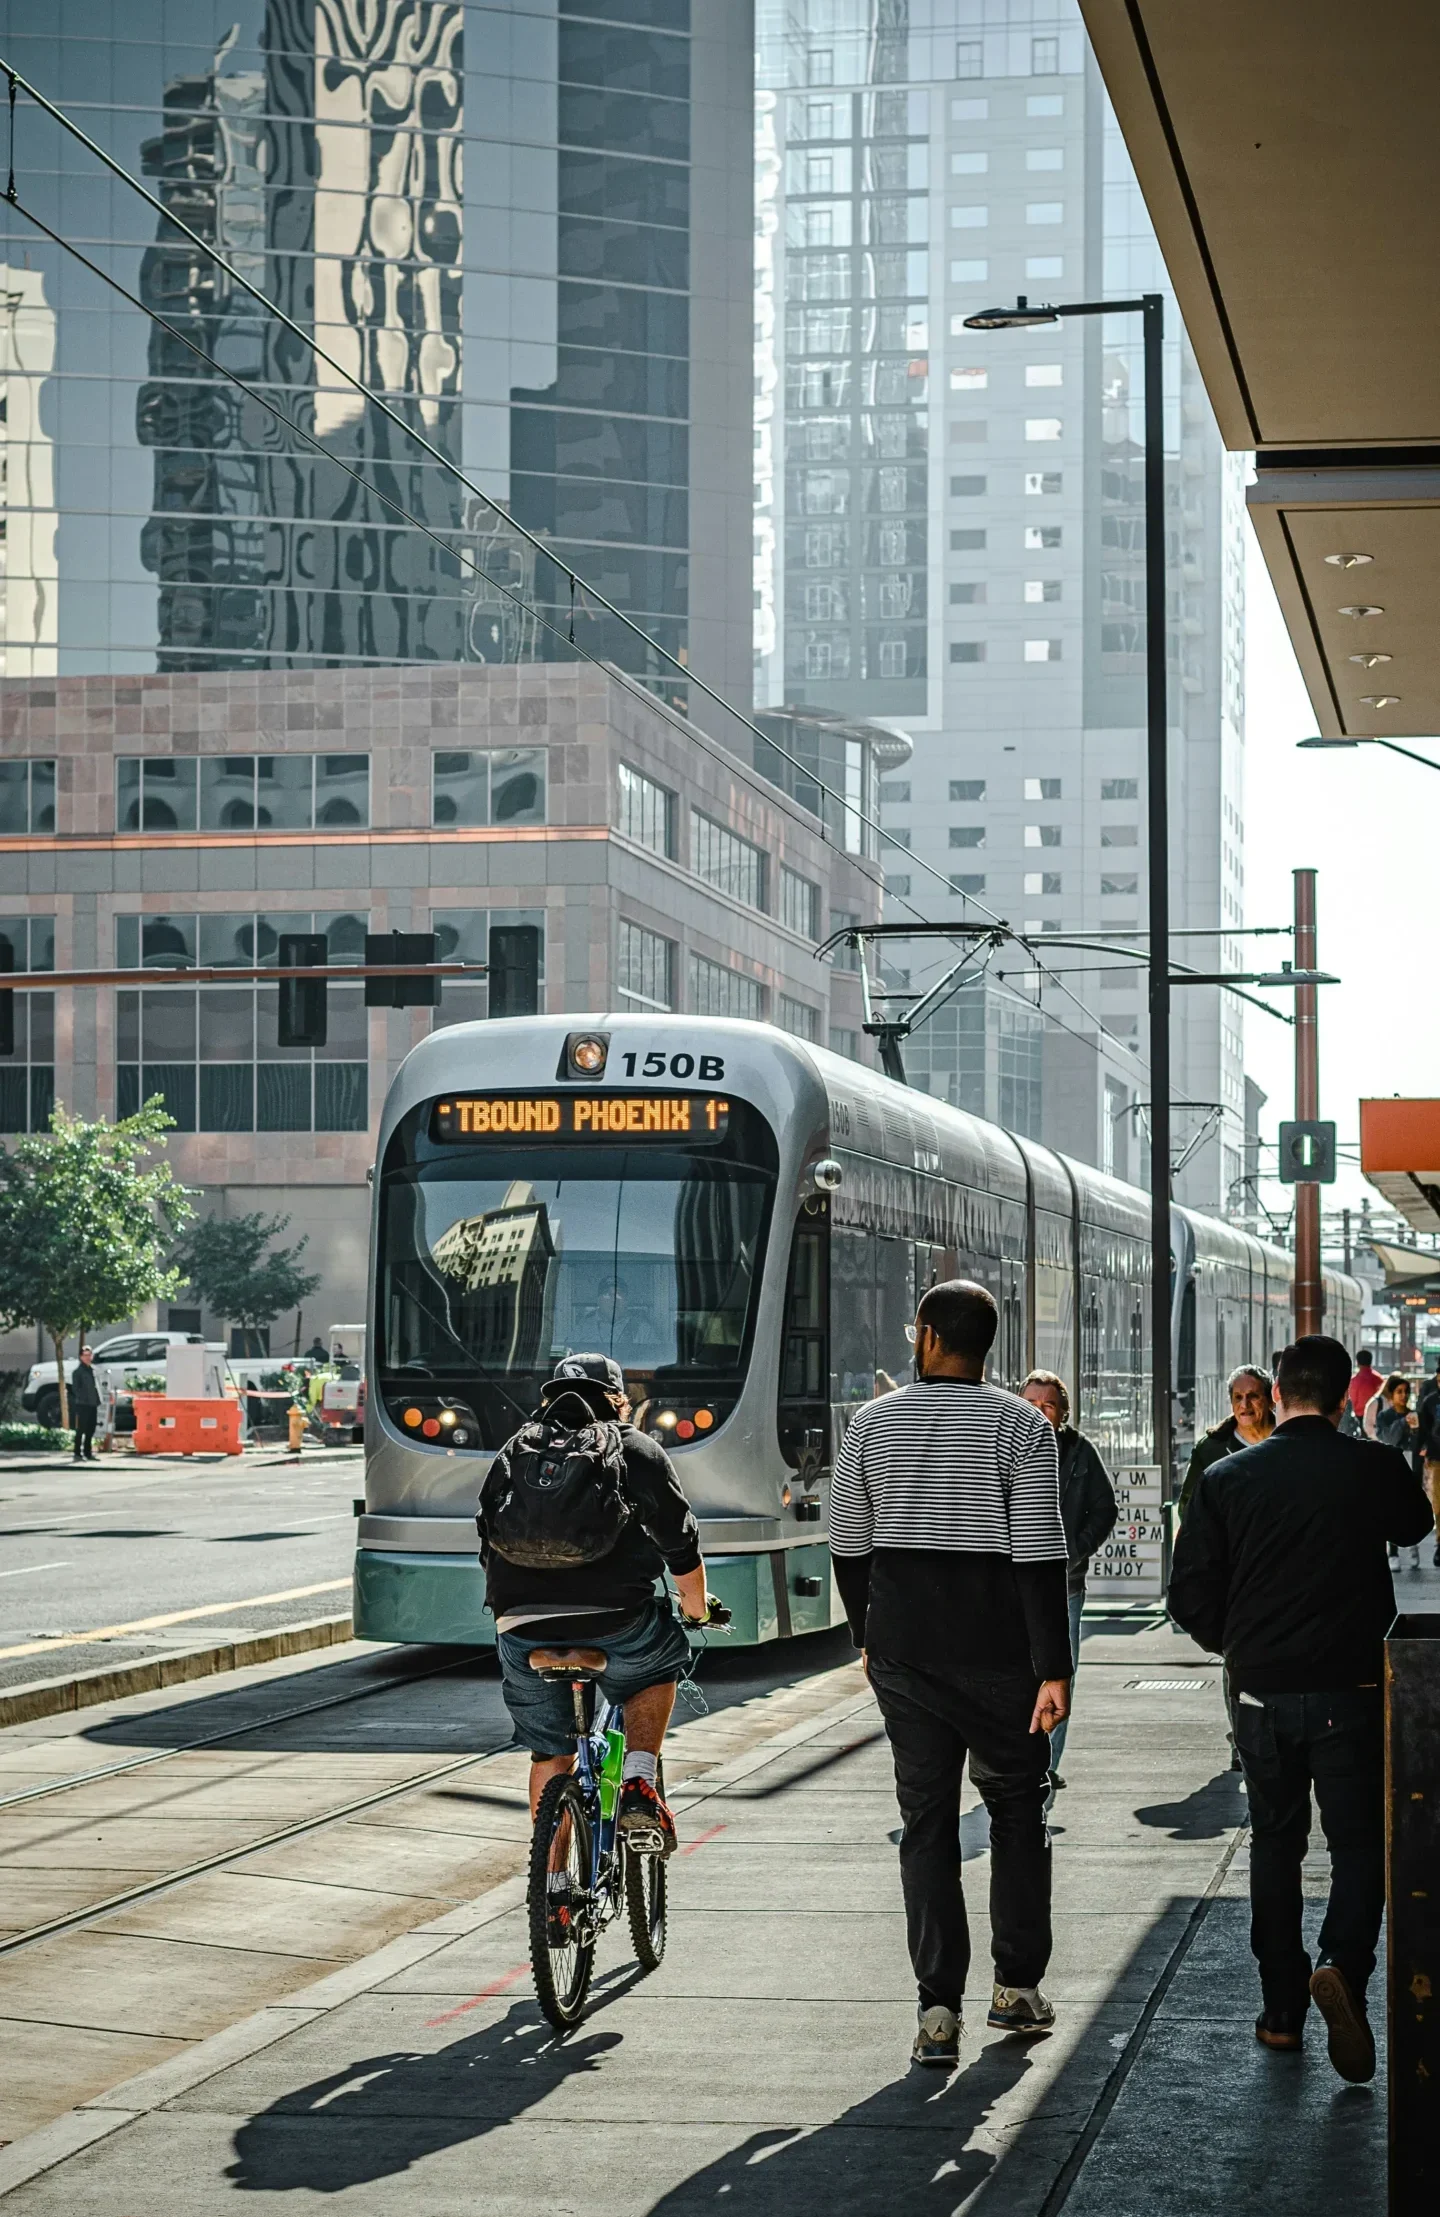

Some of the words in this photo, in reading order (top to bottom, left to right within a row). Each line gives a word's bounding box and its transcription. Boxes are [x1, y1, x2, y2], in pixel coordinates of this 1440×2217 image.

[621, 1052, 725, 1082] 150B
[456, 1101, 560, 1132] TBOUND
[574, 1100, 690, 1131] PHOENIX
[1094, 1562, 1143, 1576] ENJOY
